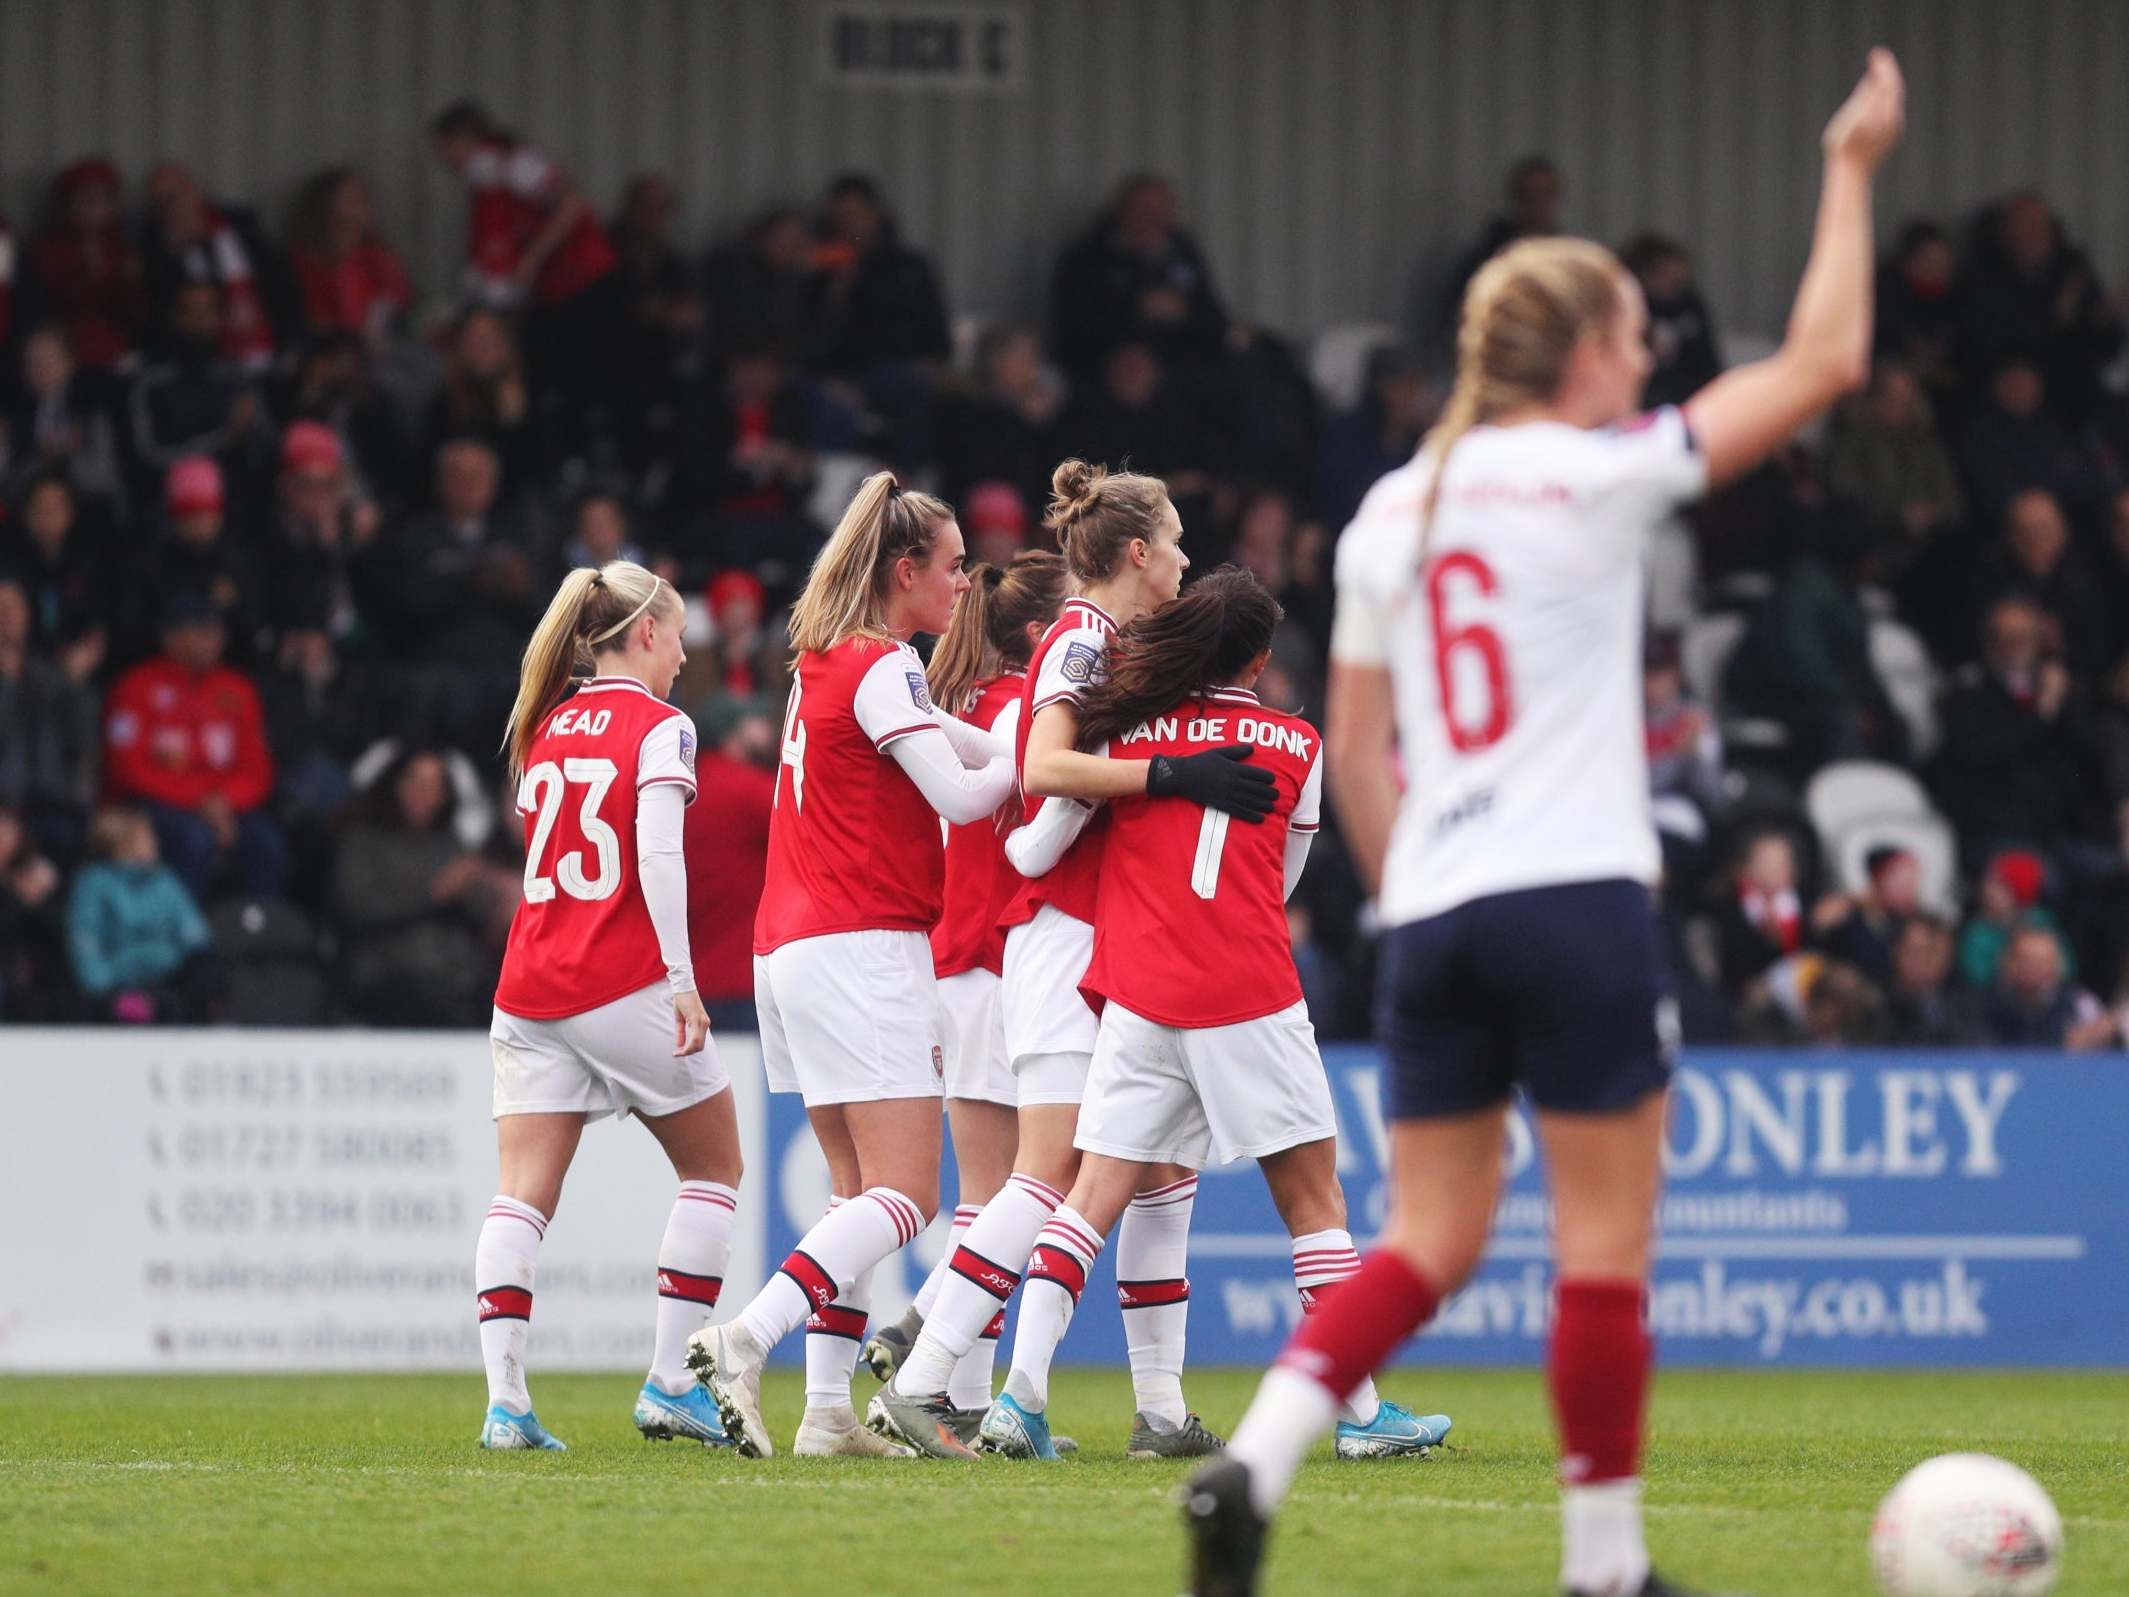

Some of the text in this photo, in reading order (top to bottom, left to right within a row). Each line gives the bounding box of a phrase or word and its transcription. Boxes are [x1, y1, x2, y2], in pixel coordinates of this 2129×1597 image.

[1427, 550, 1516, 752] 6
[546, 709, 612, 738] MEAD
[1187, 718, 1227, 742] DE
[1237, 718, 1313, 762] DONK
[522, 758, 622, 904] 23
[1658, 1067, 2022, 1178] ONLEY
